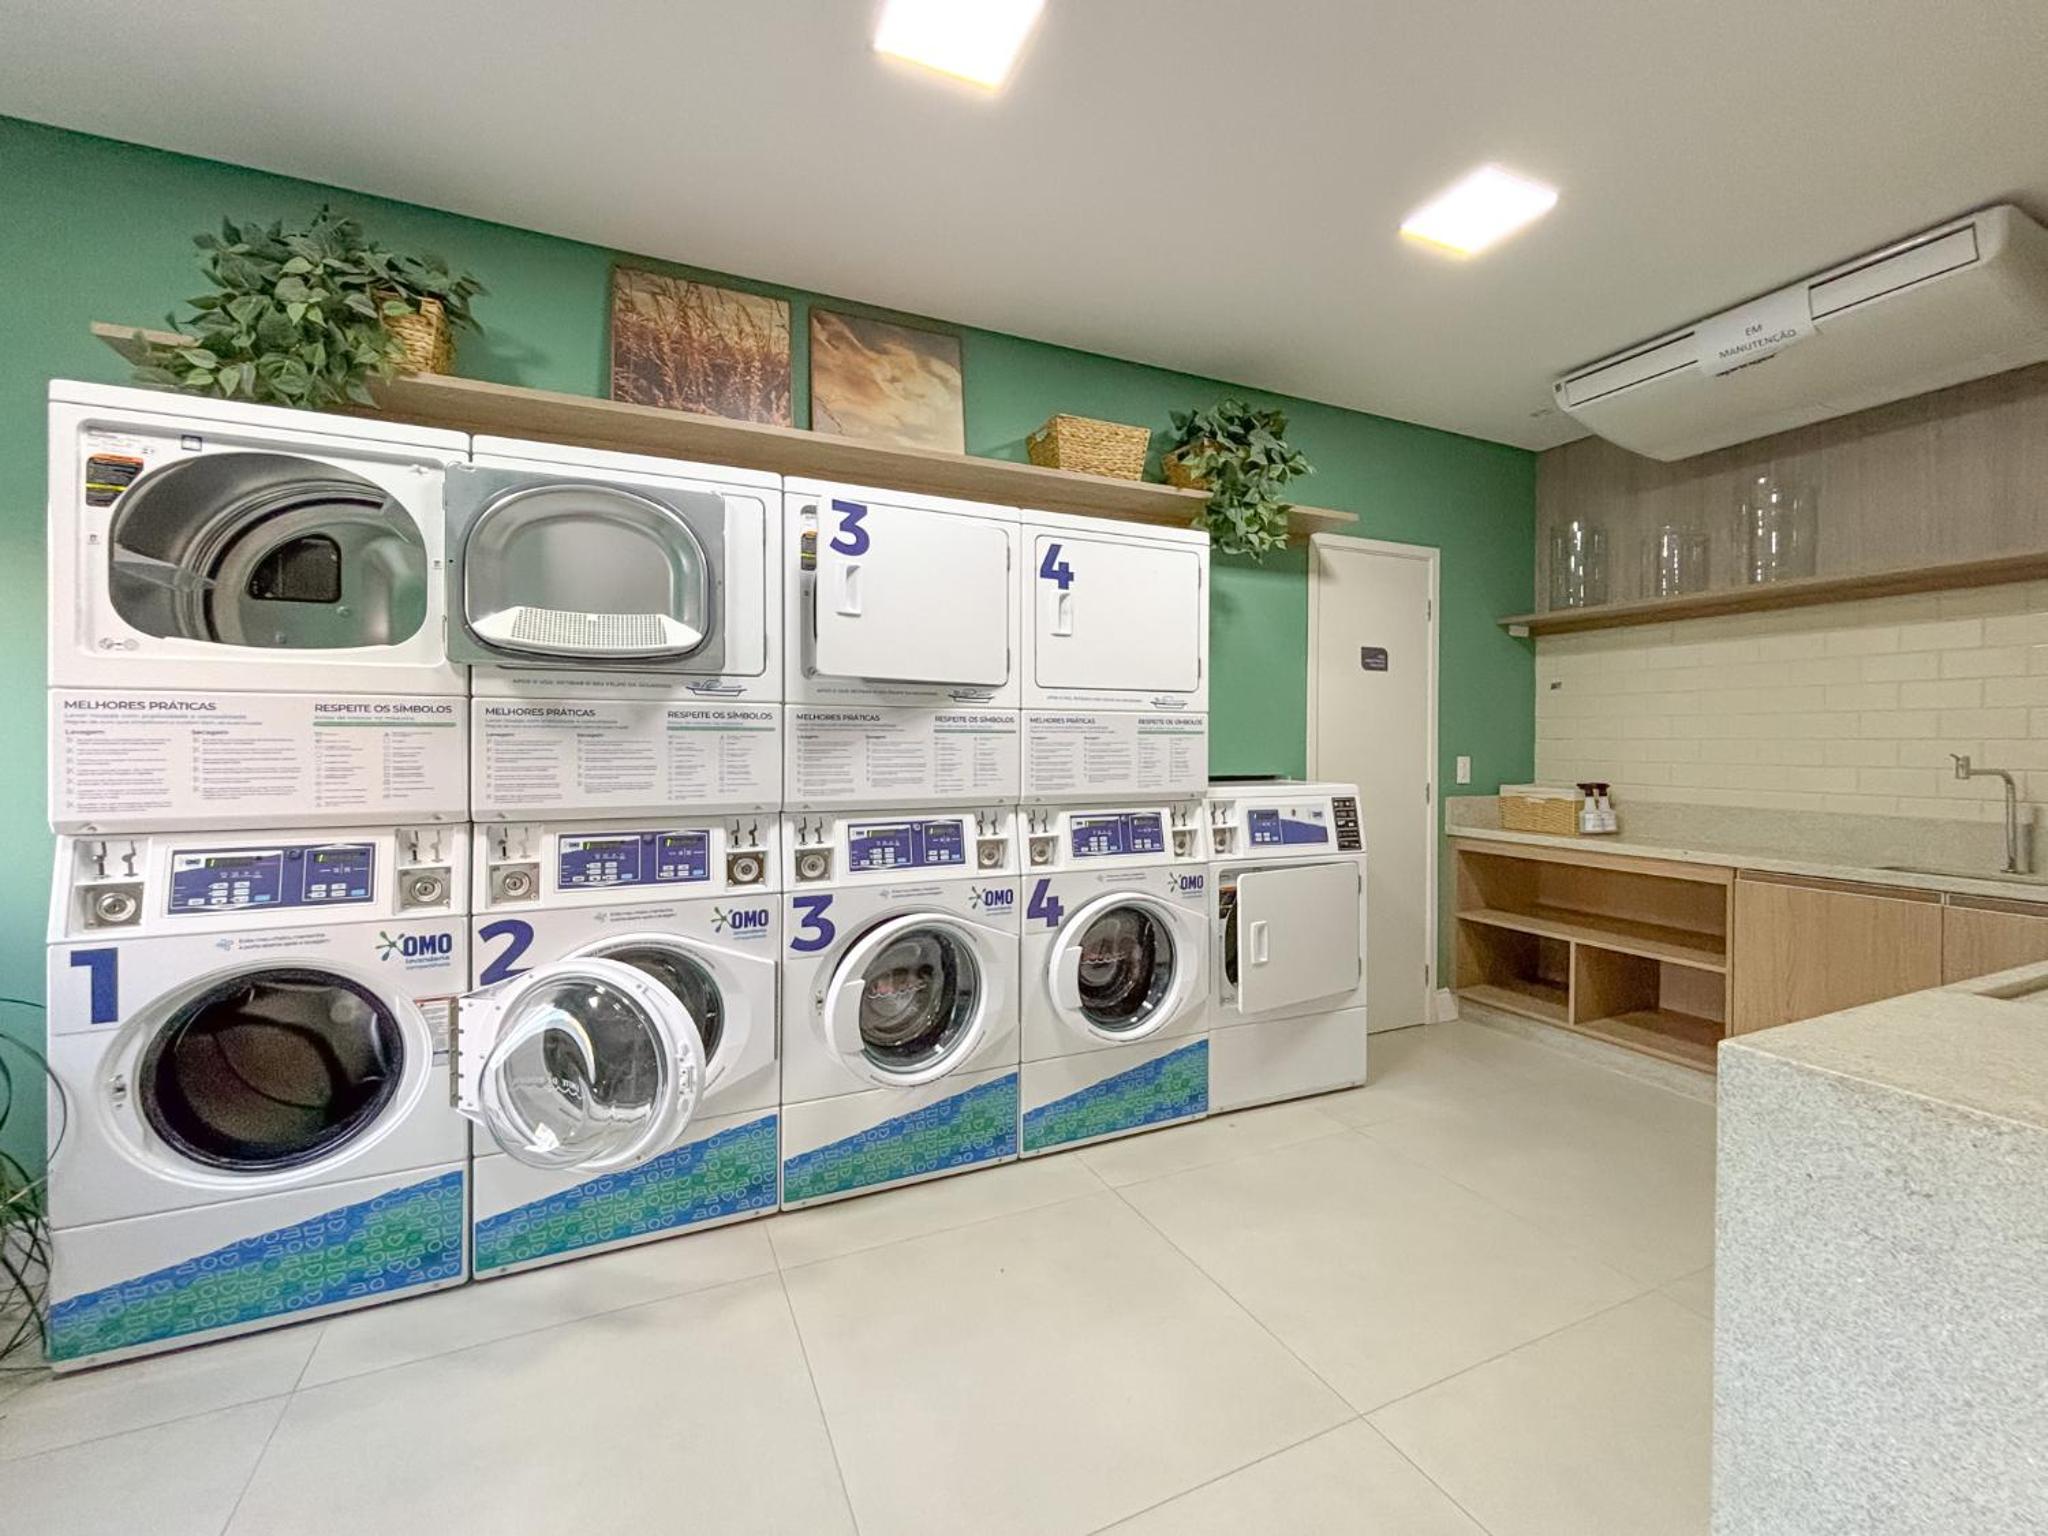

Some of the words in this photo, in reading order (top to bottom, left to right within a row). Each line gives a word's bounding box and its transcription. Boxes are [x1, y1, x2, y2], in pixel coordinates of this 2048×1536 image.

[1745, 324, 1763, 336] EM
[1718, 328, 1797, 359] MANUTENÇÃO
[829, 498, 871, 557] 3
[1039, 543, 1075, 590] 4
[63, 699, 146, 711] MELHORES
[149, 699, 217, 712] PRÁTICAS
[314, 703, 372, 714] RESPEITE
[373, 704, 391, 714] OS
[392, 703, 453, 714] SÍMBOLOS
[485, 707, 544, 717] MELHORES
[546, 707, 596, 718] PRÁTICAS
[667, 710, 711, 720] RESPEITE
[713, 711, 726, 720] OS
[727, 710, 774, 721] SÍMBOLOS
[796, 713, 841, 722] MELHORES
[842, 712, 881, 722] PRÁTICAS
[934, 715, 967, 724] RESPEITE
[1029, 716, 1065, 725] MELHORES
[1179, 875, 1204, 890] OMO
[984, 888, 1014, 907] OMO
[1026, 877, 1065, 928] 4
[731, 908, 769, 930] OMO
[789, 893, 836, 953] 3
[402, 933, 453, 957] OMO
[478, 918, 535, 987] 2
[70, 946, 119, 1025] 1
